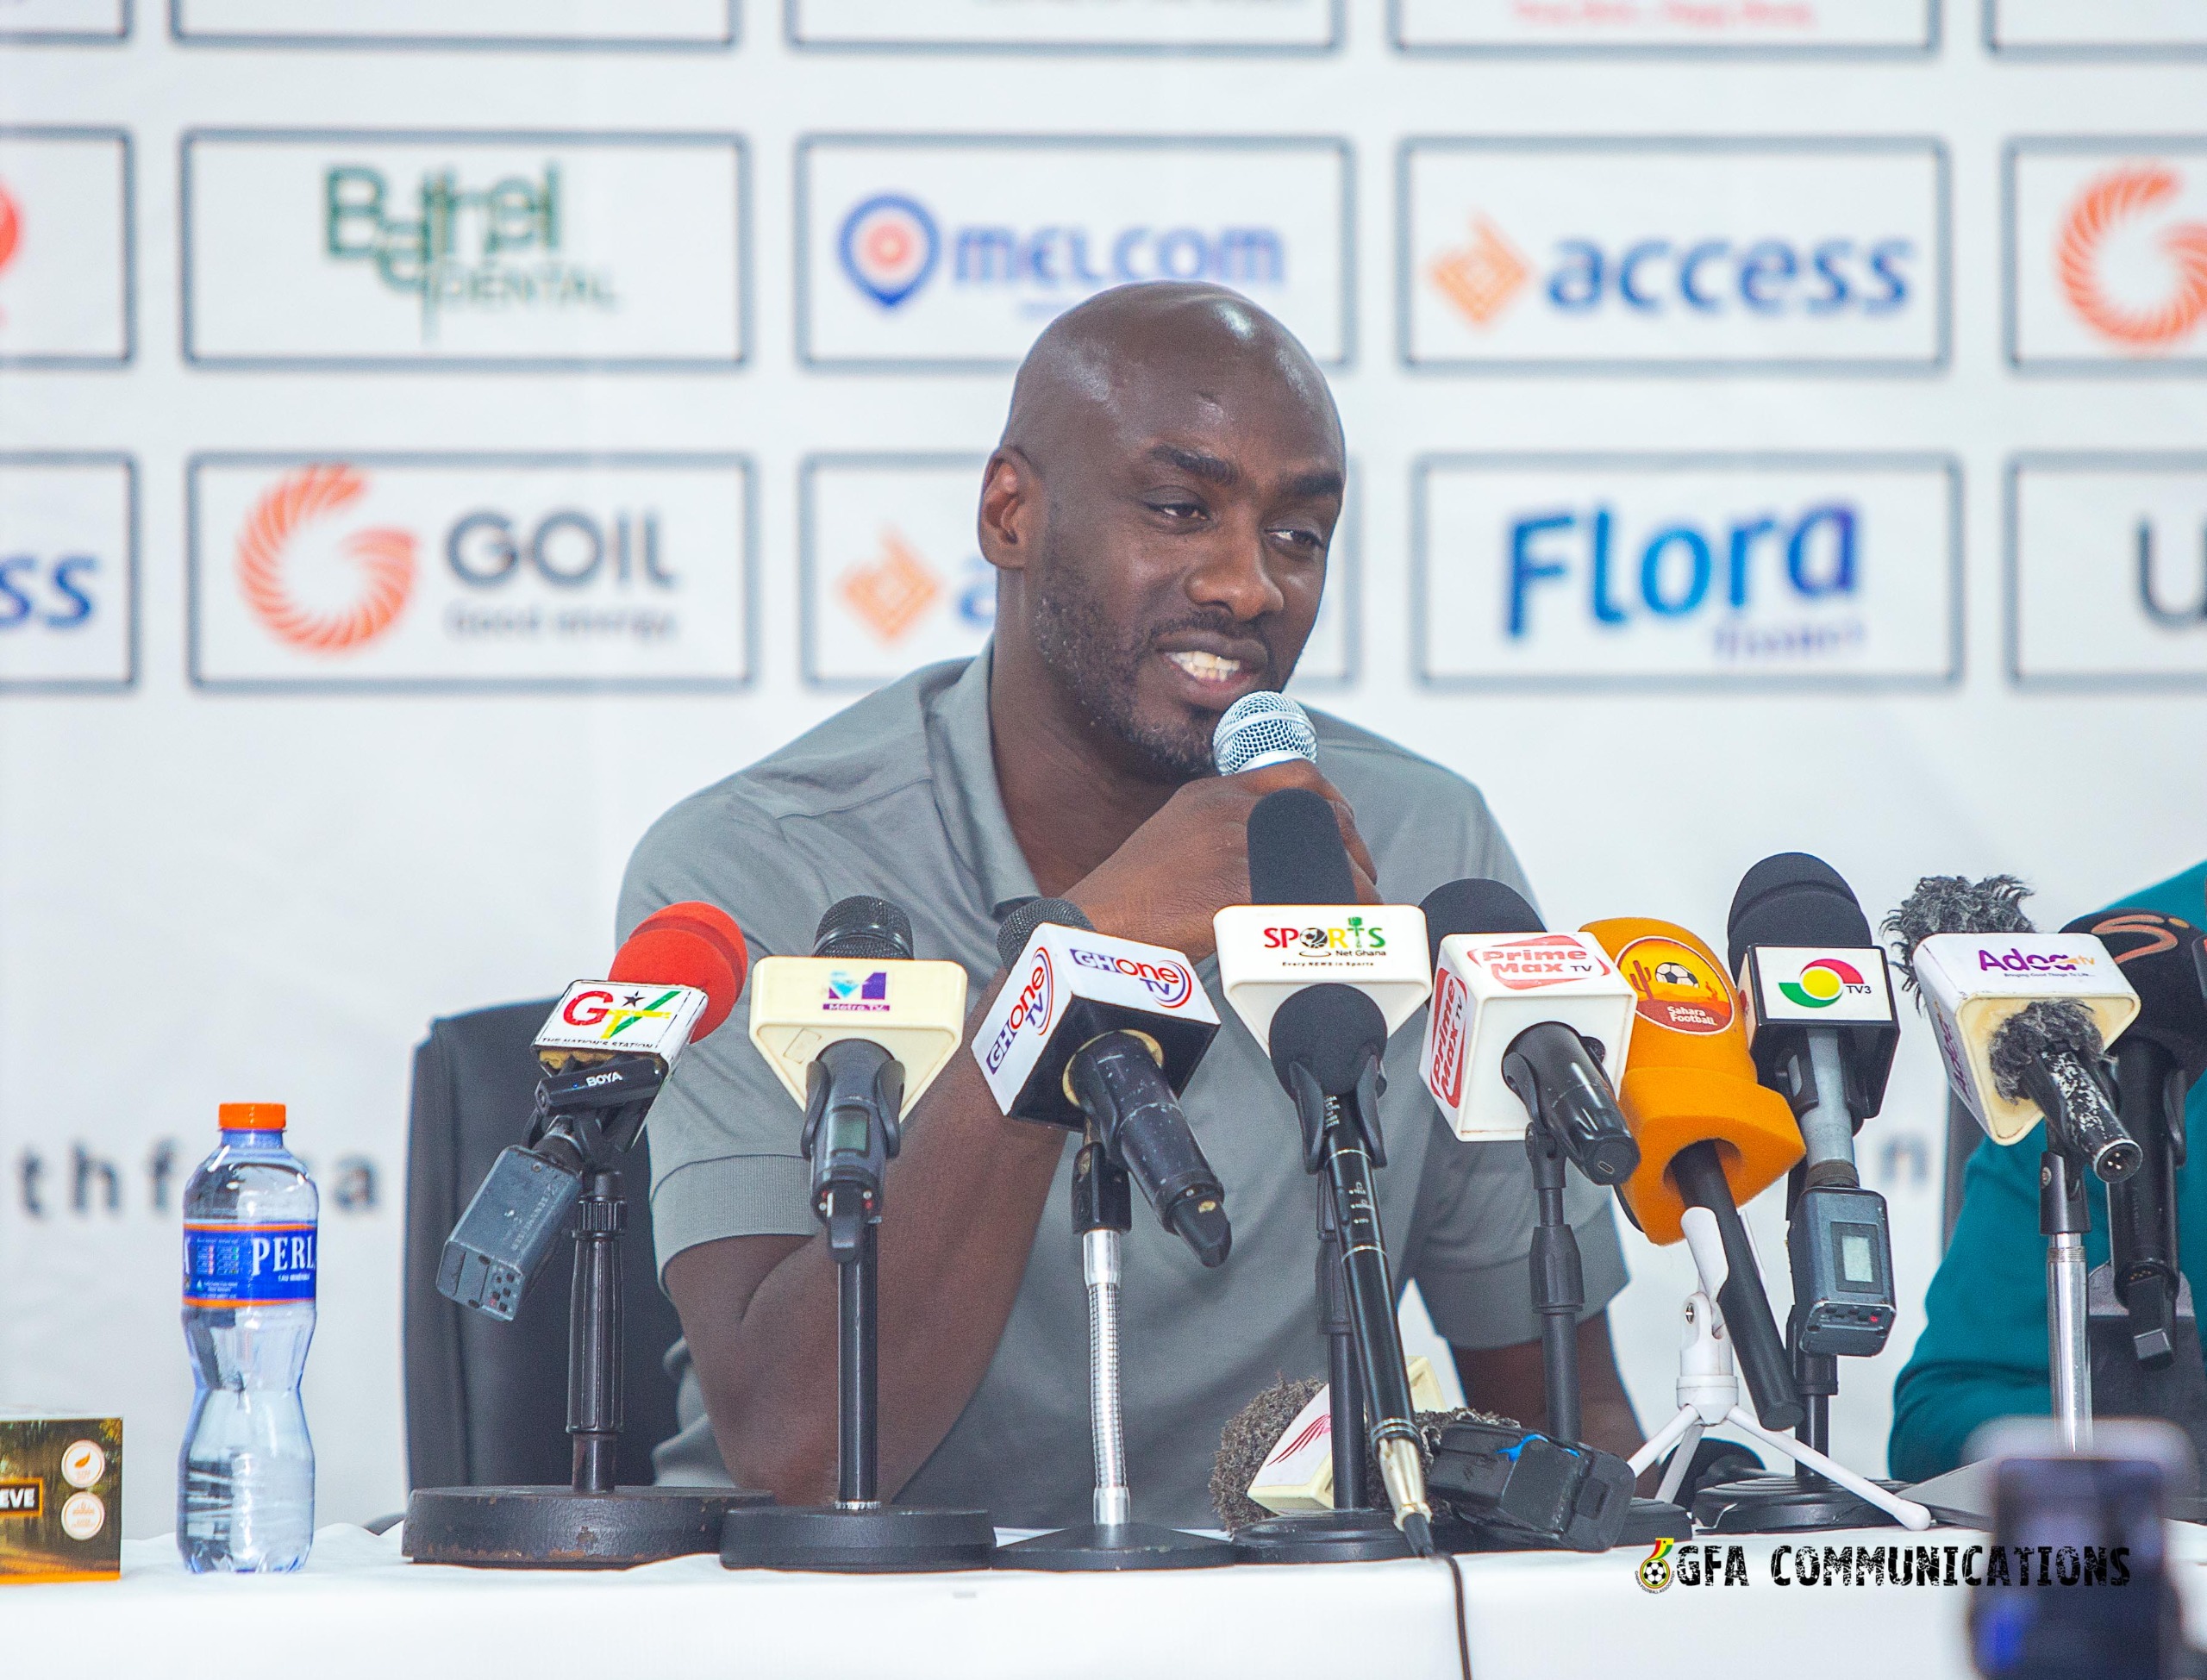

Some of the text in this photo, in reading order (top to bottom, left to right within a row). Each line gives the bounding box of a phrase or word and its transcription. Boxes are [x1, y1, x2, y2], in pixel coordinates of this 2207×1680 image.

[1545, 240, 1916, 315] access
[443, 507, 679, 590] GOIL
[1502, 497, 1862, 641] Flora
[1483, 950, 1587, 961] Prime
[1491, 963, 1564, 973] Max
[1140, 977, 1170, 996] TV
[1845, 984, 1872, 995] TV3
[1025, 992, 1044, 1027] TV
[1455, 996, 1463, 1021] TV
[1666, 1005, 1706, 1016] Sahara
[585, 1071, 623, 1087] BOYA
[251, 1235, 316, 1276] PERL
